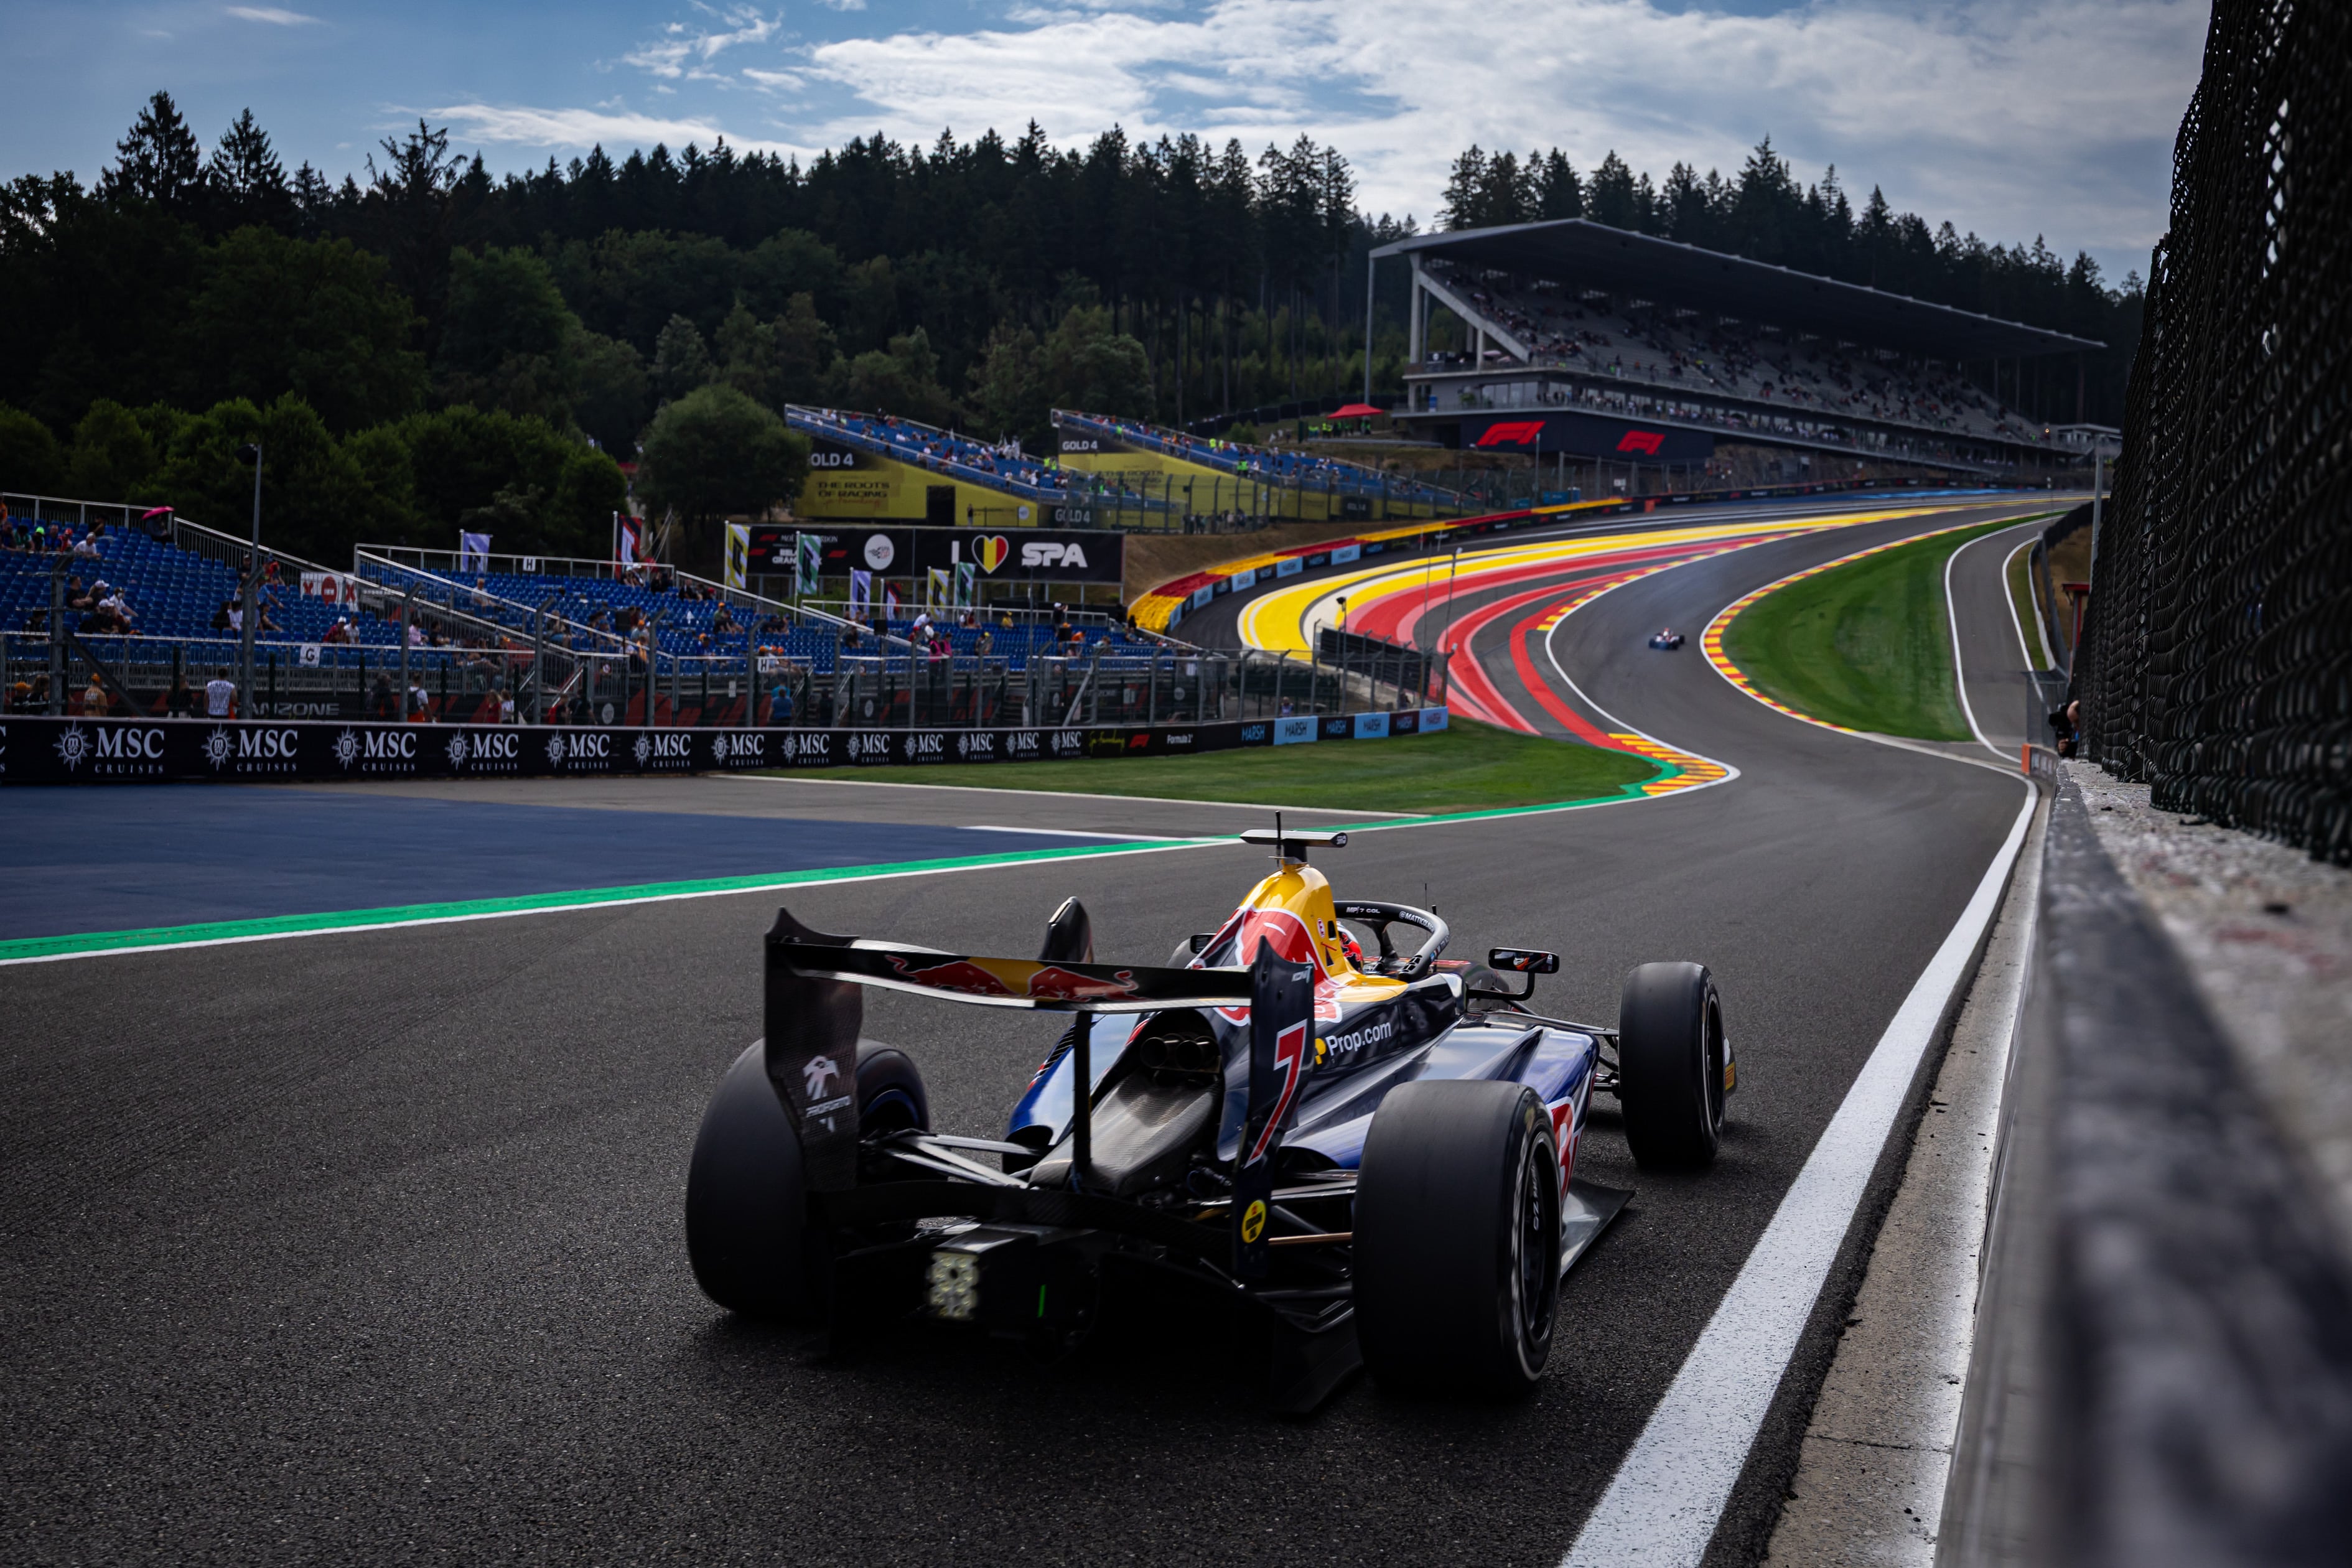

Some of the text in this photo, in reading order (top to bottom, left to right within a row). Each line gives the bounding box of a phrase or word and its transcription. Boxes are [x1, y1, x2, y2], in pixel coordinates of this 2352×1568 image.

[1062, 440, 1098, 450] GOLD 4
[811, 453, 854, 467] OLD 4
[1083, 510, 1090, 522] 4
[951, 540, 1088, 567] I SPA
[306, 648, 315, 661] G
[760, 660, 767, 671] H
[1241, 724, 1266, 741] MARSH
[1286, 722, 1307, 737] MARSH
[1326, 720, 1346, 735] MARSH
[1363, 719, 1381, 732] MARSH
[95, 727, 164, 758] MSC
[238, 729, 298, 758] MSC
[363, 730, 416, 758] MSC
[472, 732, 519, 758] MSC
[569, 734, 610, 758] MSC
[653, 734, 691, 757] MSC
[730, 734, 764, 755] MSC
[799, 734, 829, 754] MSC
[862, 734, 890, 754] MSC
[918, 734, 944, 753] MSC
[971, 733, 994, 751] MSC
[1017, 732, 1039, 749] MSC
[1062, 731, 1081, 748] MSC
[1167, 734, 1188, 744] Formula
[95, 763, 164, 774] CRUISES
[237, 762, 297, 772] CRUISES
[362, 762, 415, 772] CRUISES
[471, 762, 518, 771] CRUISES
[568, 761, 609, 770] CRUISES
[653, 760, 691, 768] CRUISES
[1325, 1022, 1392, 1057] Prop.com
[1243, 1018, 1308, 1170] 7
